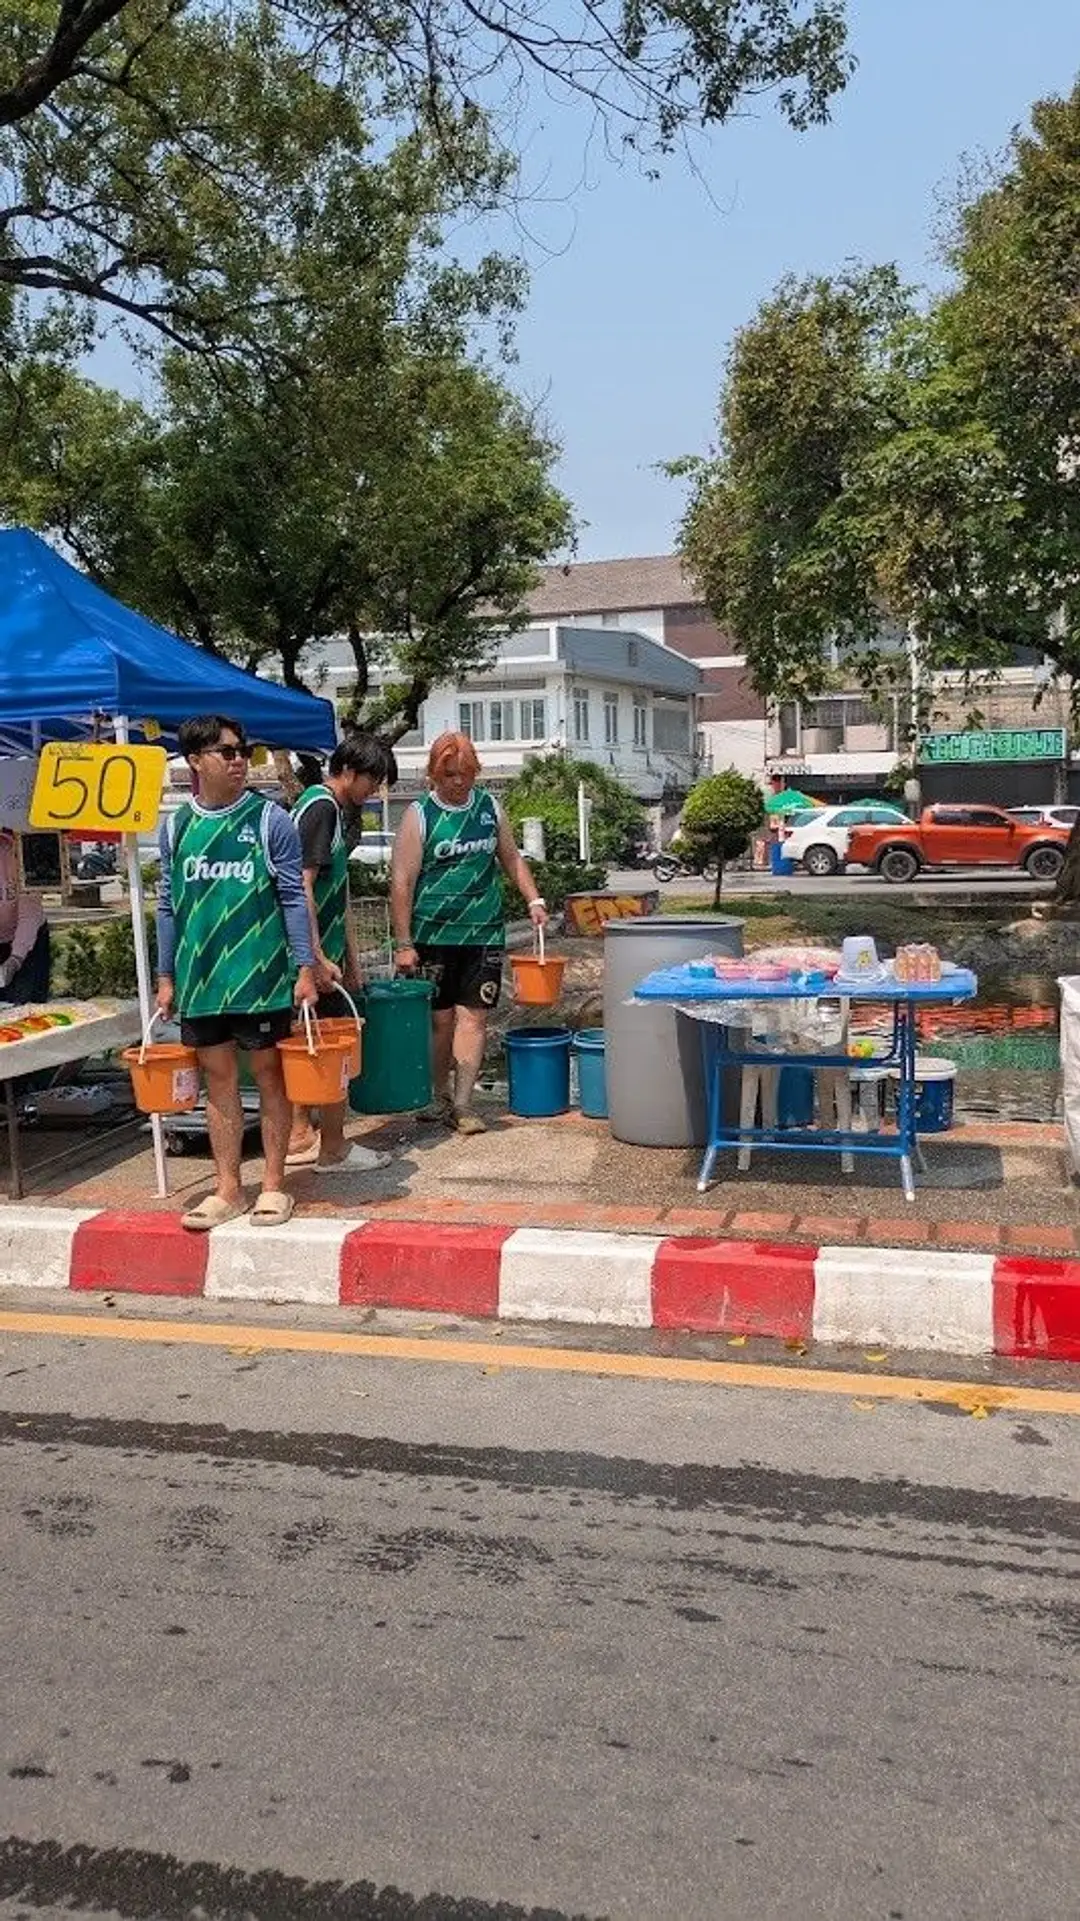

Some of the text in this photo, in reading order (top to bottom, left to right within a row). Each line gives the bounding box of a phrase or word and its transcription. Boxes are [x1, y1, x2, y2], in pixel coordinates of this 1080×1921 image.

[48, 755, 137, 819] 50
[434, 837, 498, 859] Chang
[183, 854, 255, 884] Chang
